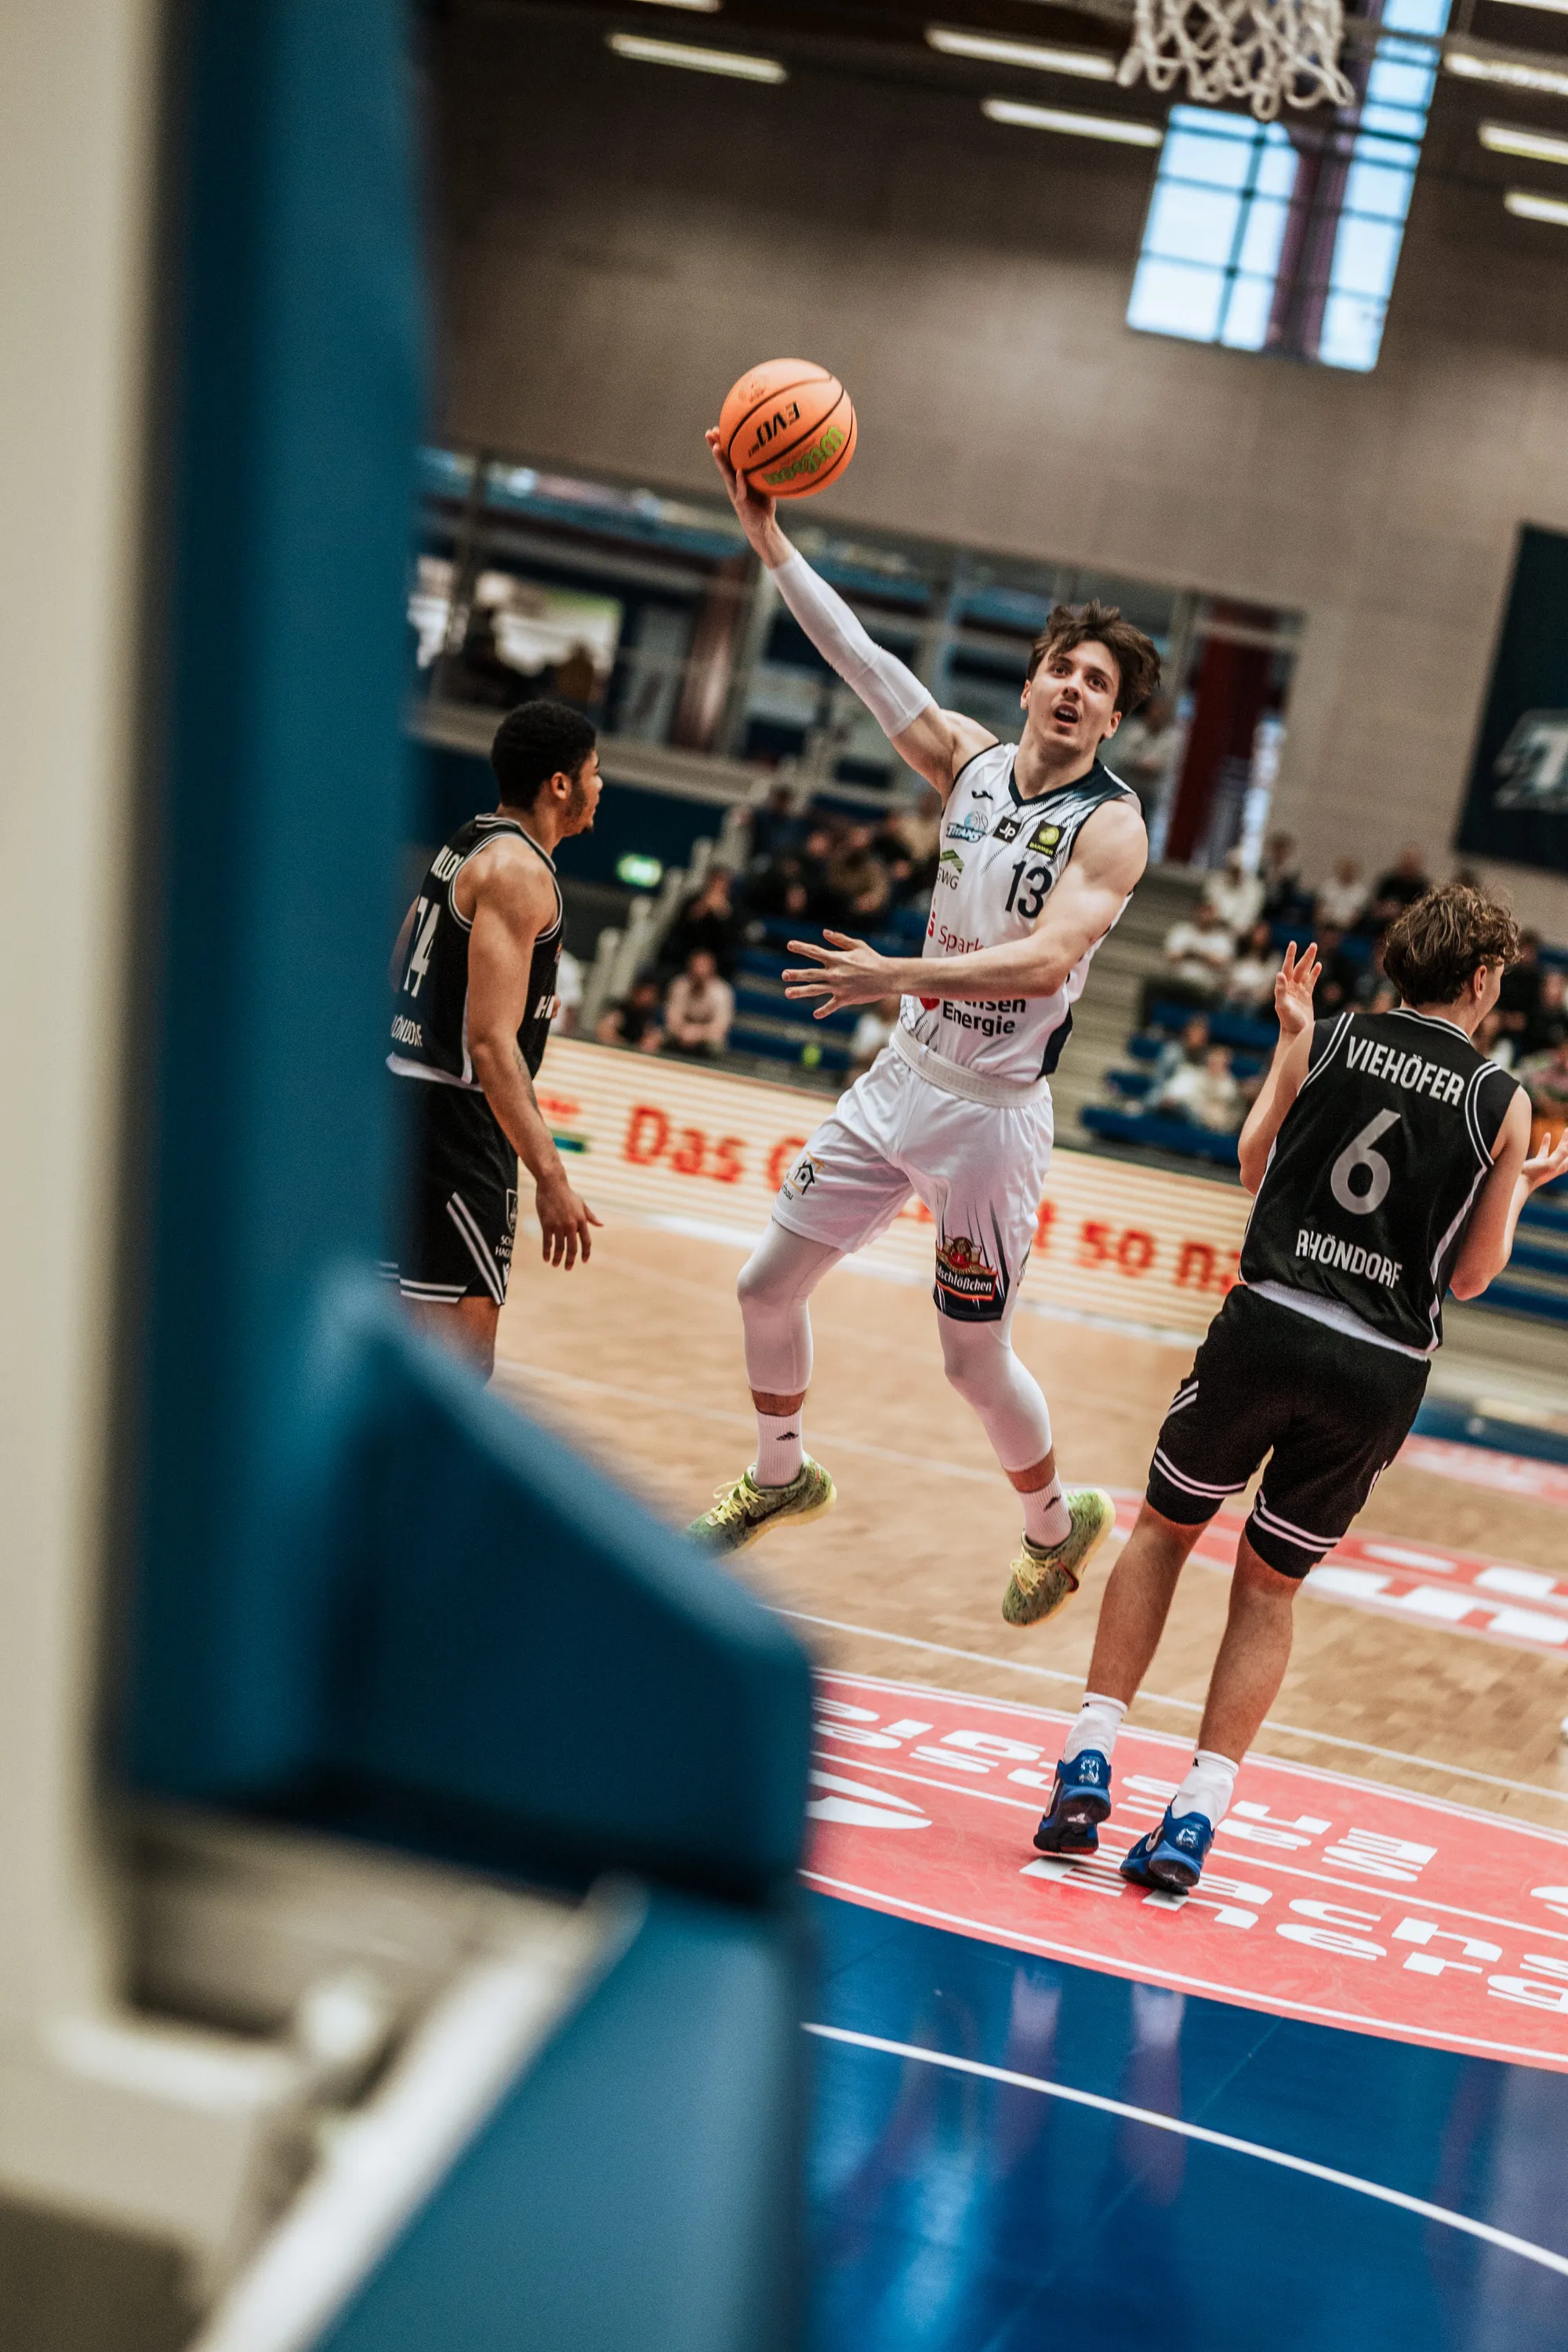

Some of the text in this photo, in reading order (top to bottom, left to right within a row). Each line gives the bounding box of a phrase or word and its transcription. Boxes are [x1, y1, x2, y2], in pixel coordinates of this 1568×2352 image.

[757, 401, 800, 447] EVO
[763, 426, 845, 485] Wilson
[1029, 842, 1054, 855] BARMER
[1004, 861, 1052, 918] 13
[403, 895, 441, 998] 14
[942, 1000, 1015, 1037] Energie
[1346, 1035, 1465, 1106] VIEHÖFER
[624, 1104, 746, 1185] Das
[1330, 1108, 1401, 1215] 6
[1295, 1229, 1403, 1290] RHÖNDORF
